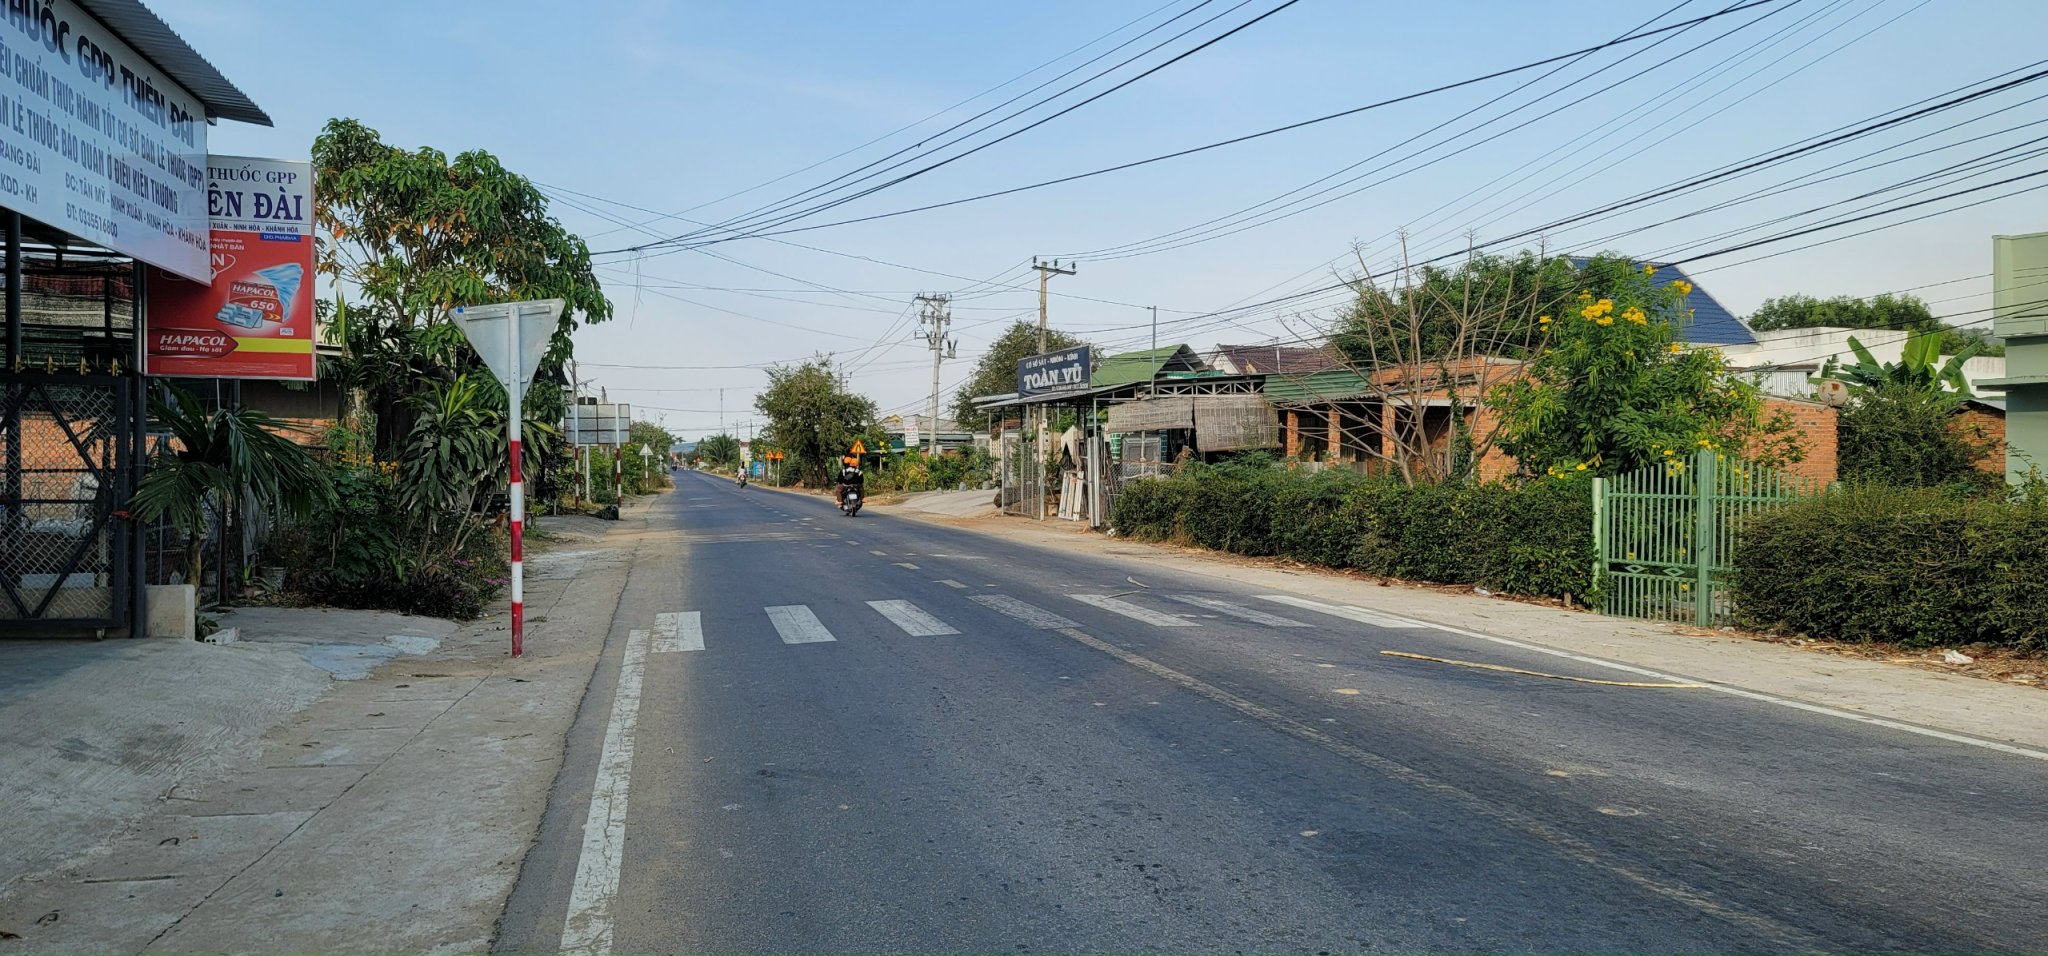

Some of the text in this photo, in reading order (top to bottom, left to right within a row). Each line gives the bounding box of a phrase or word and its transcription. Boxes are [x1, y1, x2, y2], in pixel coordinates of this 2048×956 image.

[77, 35, 115, 91] GPP
[120, 64, 166, 130] THIÊN
[170, 101, 194, 148] ĐÀI
[15, 53, 49, 101] CHUẨN
[52, 76, 74, 118] THỰC
[76, 92, 100, 132] HÀNH
[102, 101, 116, 141] TỐT
[118, 119, 127, 148] CƠ
[129, 123, 139, 156] SỞ
[141, 132, 155, 165] BÁN
[157, 139, 165, 171] LẺ
[166, 148, 186, 183] THUỐC
[187, 163, 205, 194] (GPP)
[12, 94, 24, 135] LẺ
[26, 107, 59, 153] THUỐC
[61, 122, 78, 164] BẢO
[80, 138, 104, 176] QUẢN
[114, 152, 131, 190] ĐIỀU
[132, 168, 149, 202] KIỆN
[151, 178, 178, 214] THƯỜNG
[26, 150, 41, 175] ĐÀI
[207, 163, 297, 184] THUỐC GPP
[25, 183, 38, 204] KH
[253, 185, 303, 221] ĐÀI
[78, 208, 118, 238] 0335516800
[79, 177, 93, 200] TÂN
[111, 193, 125, 214] NINH
[126, 200, 142, 222] XUÂN
[147, 212, 161, 232] NINH
[162, 218, 174, 236] HÒA
[178, 226, 195, 246] KHÁNH
[196, 232, 207, 252] HÒA
[212, 222, 228, 230] XUÂN
[248, 223, 260, 231] HÒA
[286, 224, 299, 233] HÒA
[232, 284, 275, 297] HAPACOL
[250, 300, 275, 311] 650
[159, 335, 228, 346] HAPACOL
[1024, 363, 1082, 390] TOÀN VŨ
